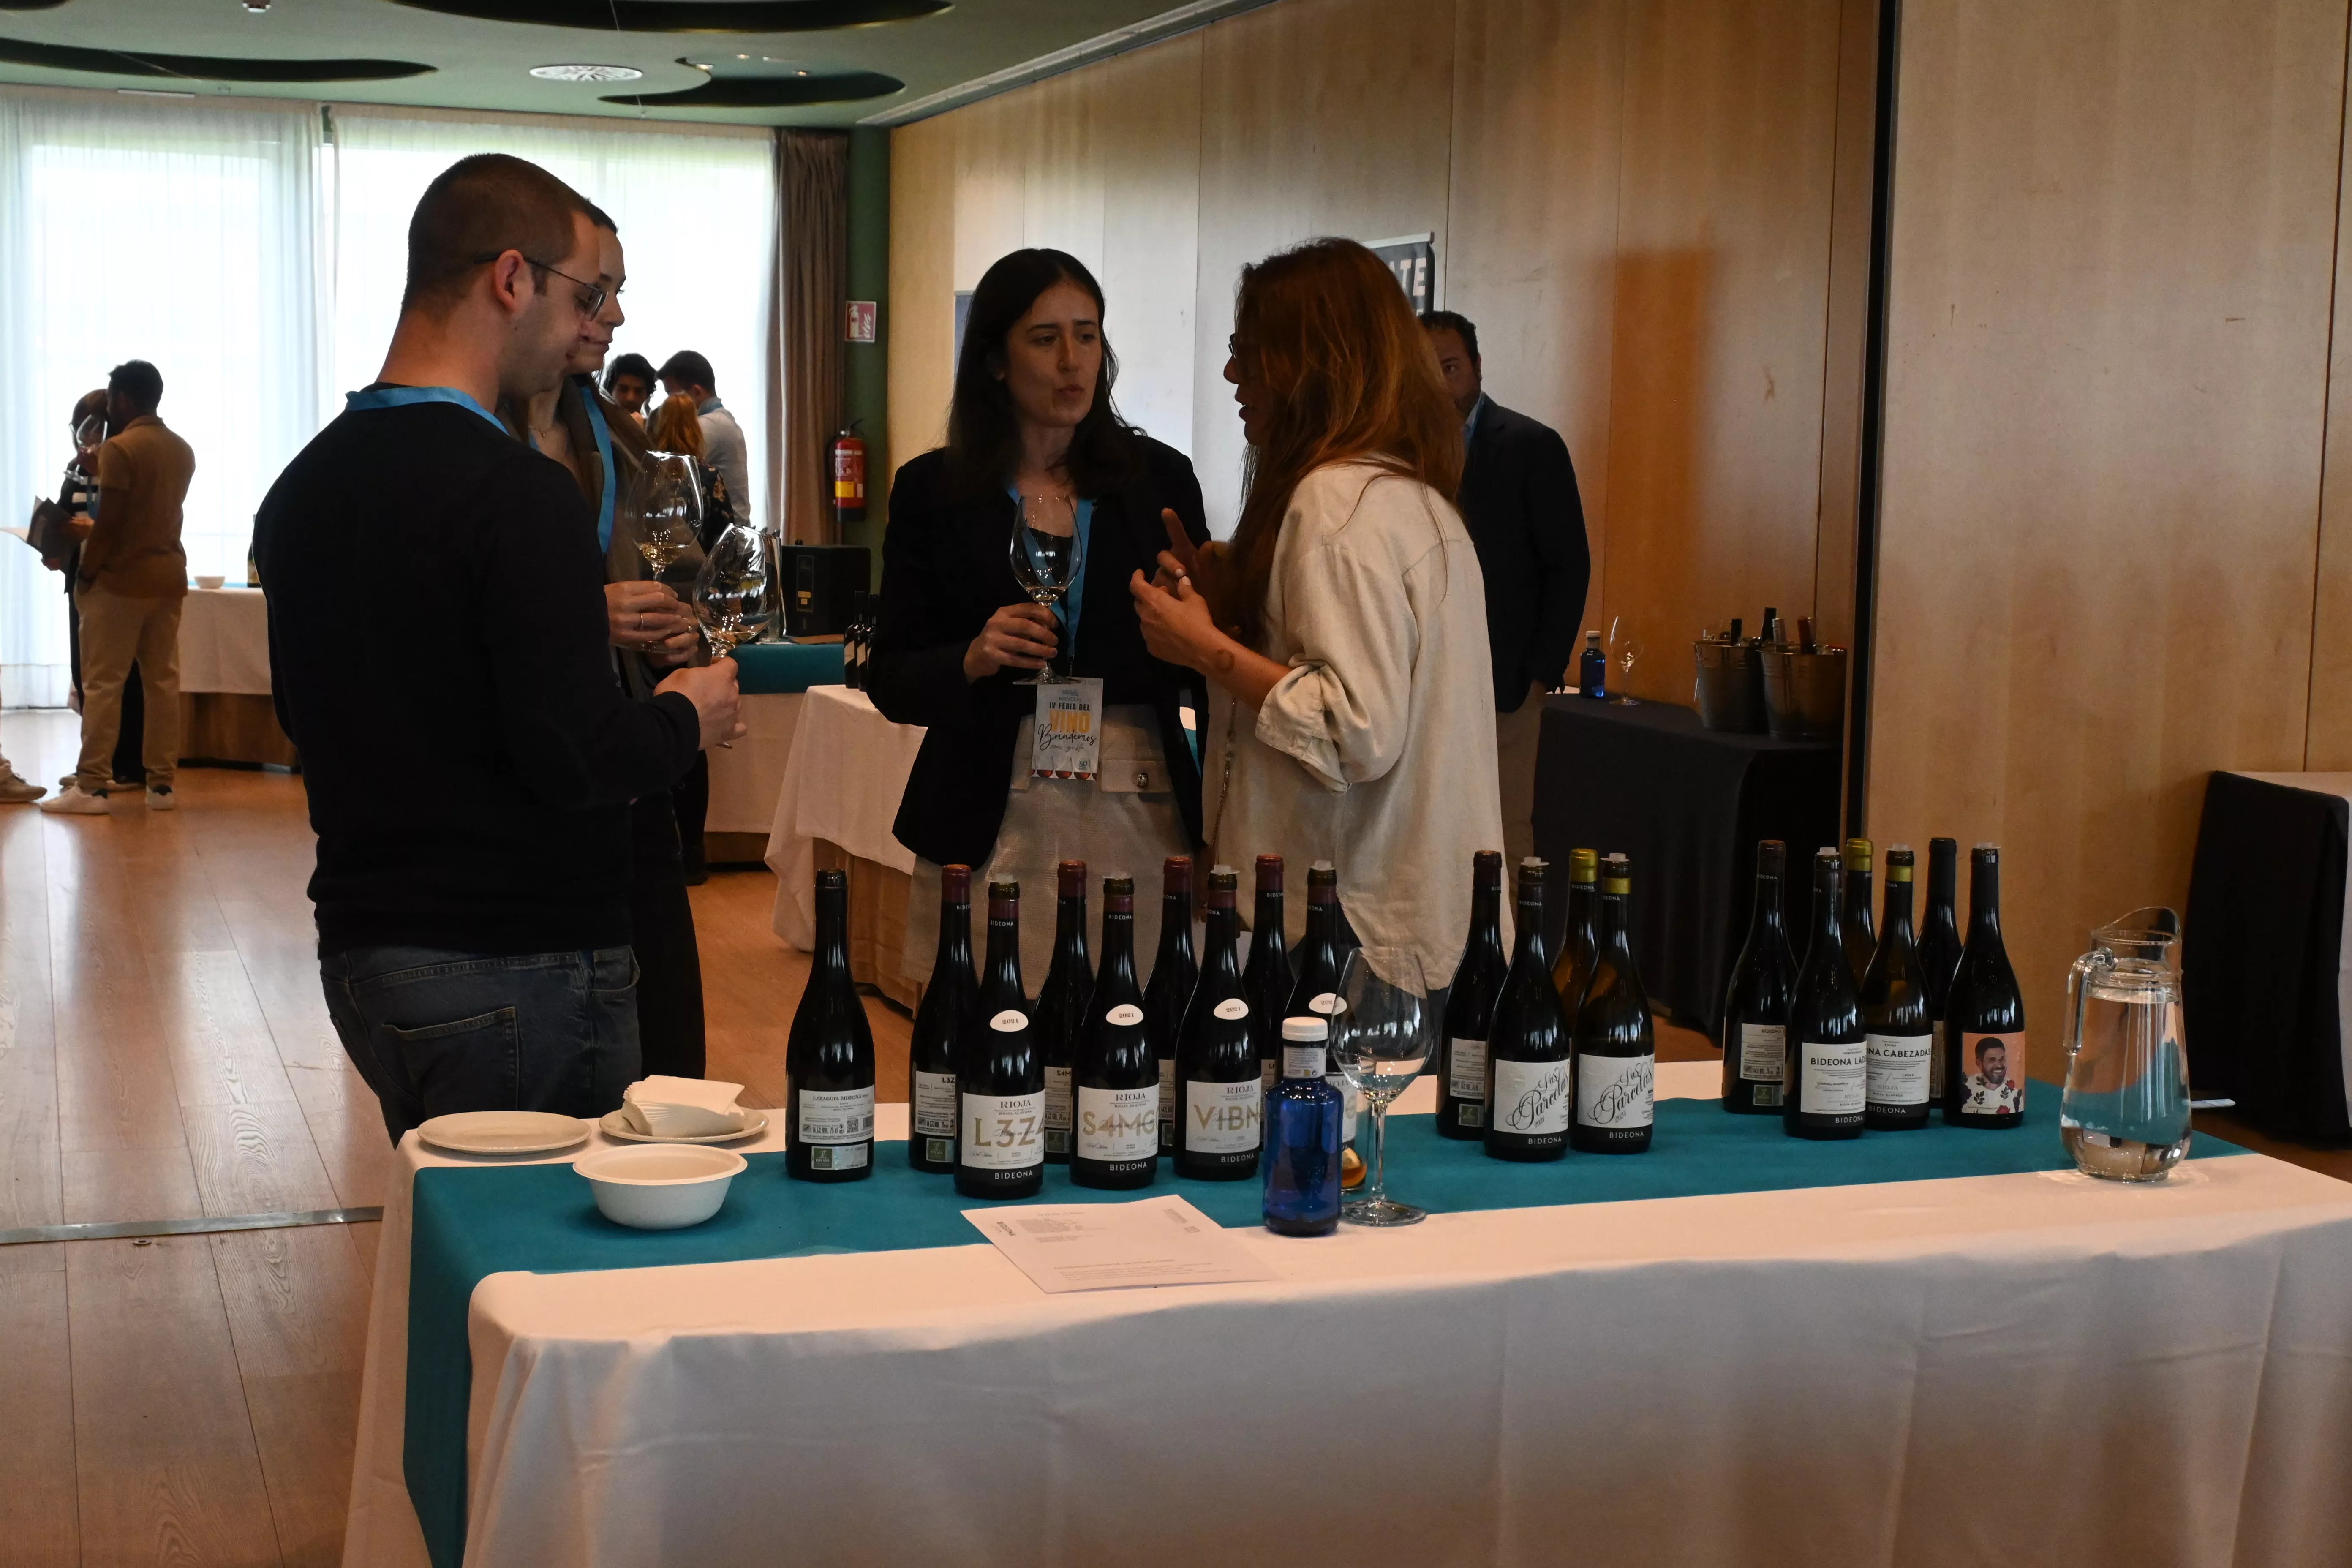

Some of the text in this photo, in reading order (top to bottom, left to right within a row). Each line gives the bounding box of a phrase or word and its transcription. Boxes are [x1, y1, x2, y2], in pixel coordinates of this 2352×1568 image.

[1049, 710, 1090, 734] VINO
[1038, 723, 1097, 751] Brindemos
[1884, 1048, 1930, 1057] CABEZADAS
[1811, 1057, 1851, 1066] BIDEONA
[1227, 1085, 1254, 1094] RIOJA
[1588, 1058, 1653, 1124] Parcelas
[1116, 1093, 1146, 1101] RIOJA
[1506, 1062, 1569, 1131] Parcelas
[1000, 1100, 1031, 1108] RIOJA
[1868, 1105, 1906, 1113] BIDEONA
[1193, 1101, 1260, 1131] V1BN
[1835, 1115, 1863, 1124] BIDEONA
[1528, 1136, 1562, 1144] BIDEONA
[1221, 1153, 1255, 1163] BIDEONA
[1110, 1162, 1147, 1171] BIDEONA
[995, 1170, 1033, 1179] BIDEONA
